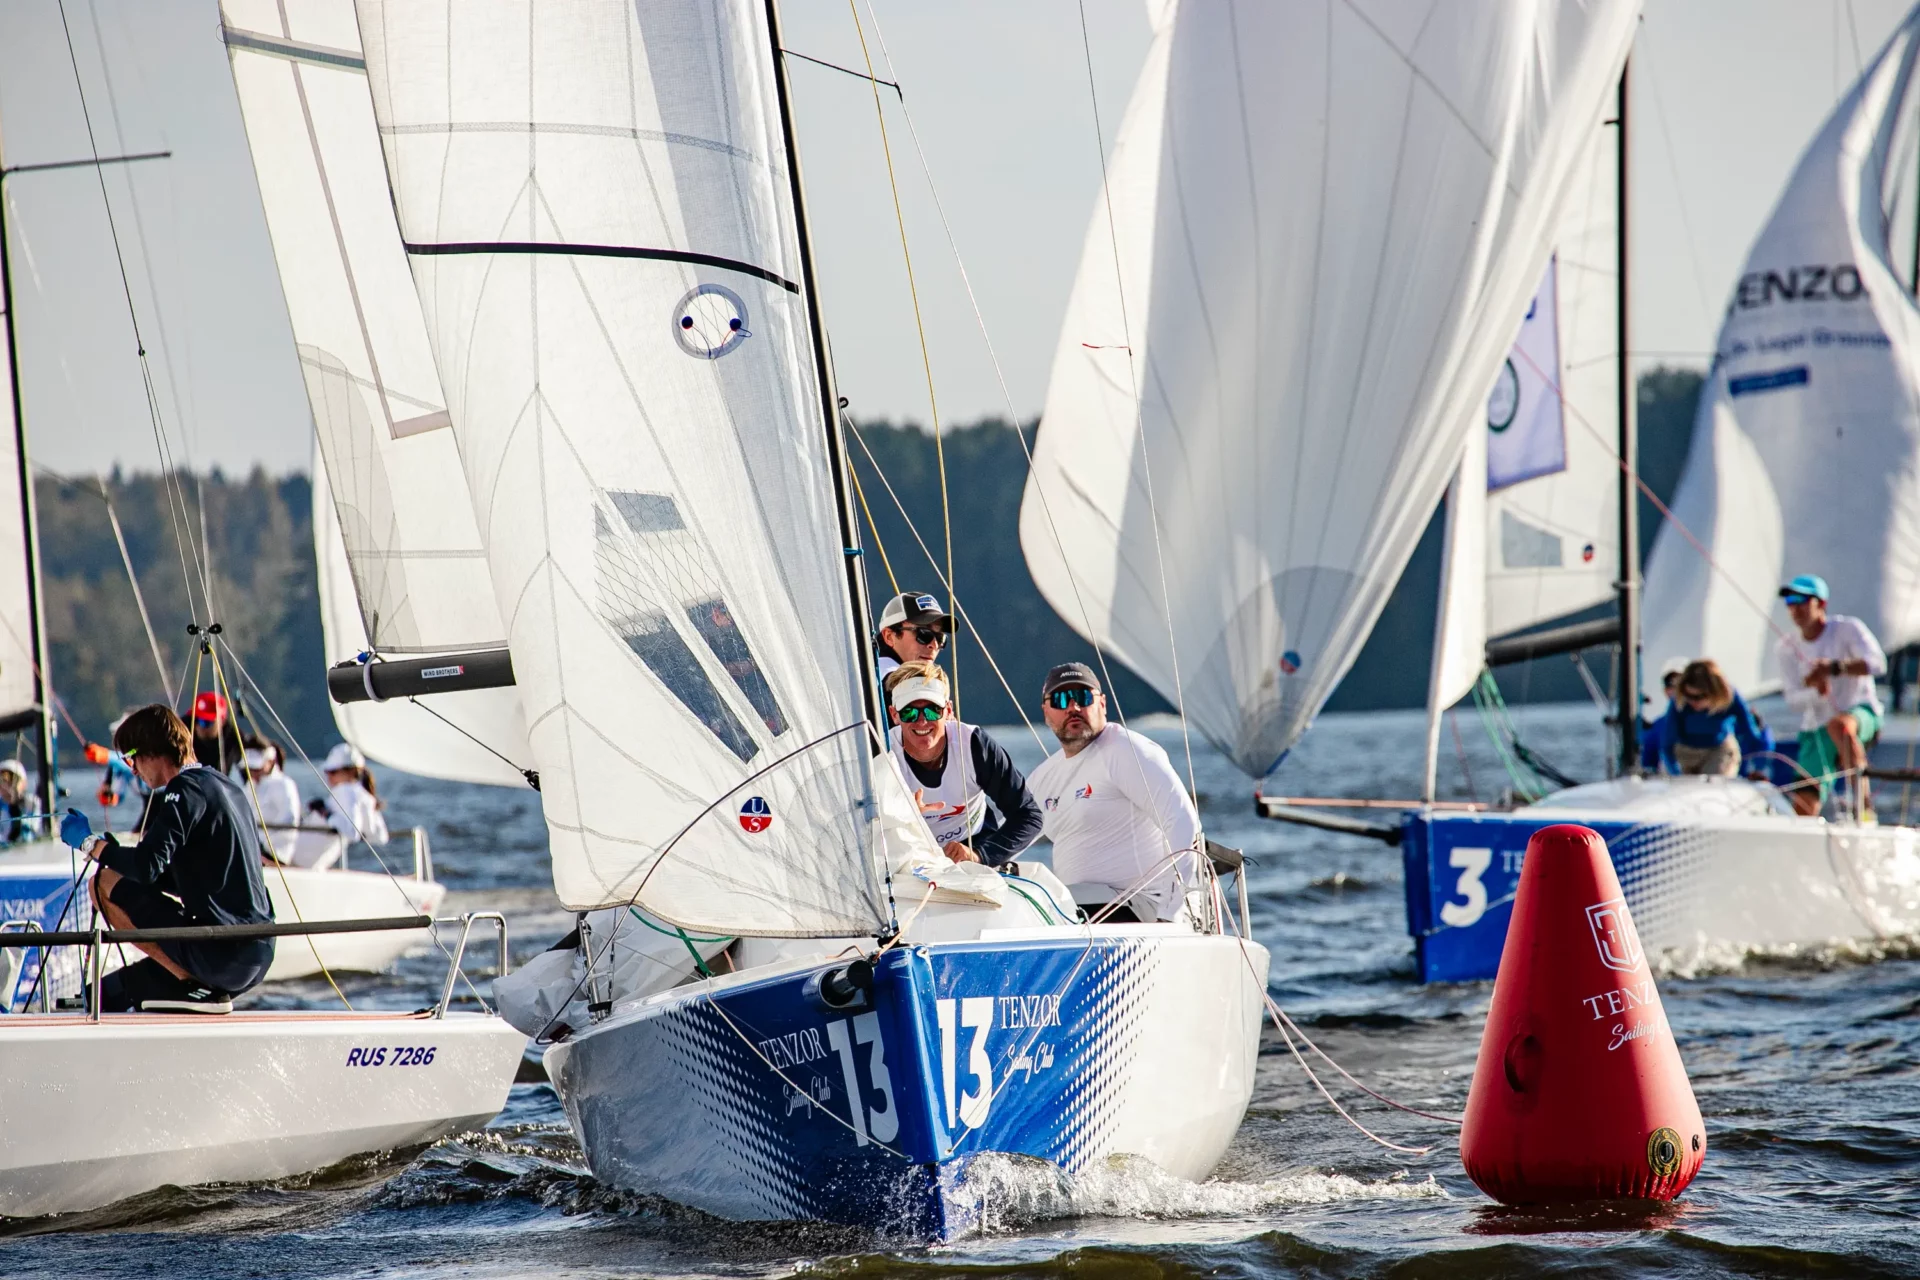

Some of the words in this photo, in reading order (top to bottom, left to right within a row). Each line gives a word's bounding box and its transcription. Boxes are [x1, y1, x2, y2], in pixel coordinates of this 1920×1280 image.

[1733, 262, 1867, 311] ENZO
[1440, 846, 1493, 928] 3
[998, 994, 1062, 1030] TENZOR
[1583, 980, 1656, 1021] TENZ
[345, 1046, 388, 1067] RUS
[389, 1046, 438, 1066] 7286
[758, 1027, 828, 1072] TENZOR
[1608, 1019, 1655, 1051] Sailing
[826, 1010, 900, 1148] 13
[936, 996, 994, 1130] 13
[1033, 1041, 1056, 1075] Club
[782, 1083, 812, 1120] Sailing
[811, 1075, 831, 1109] Club
